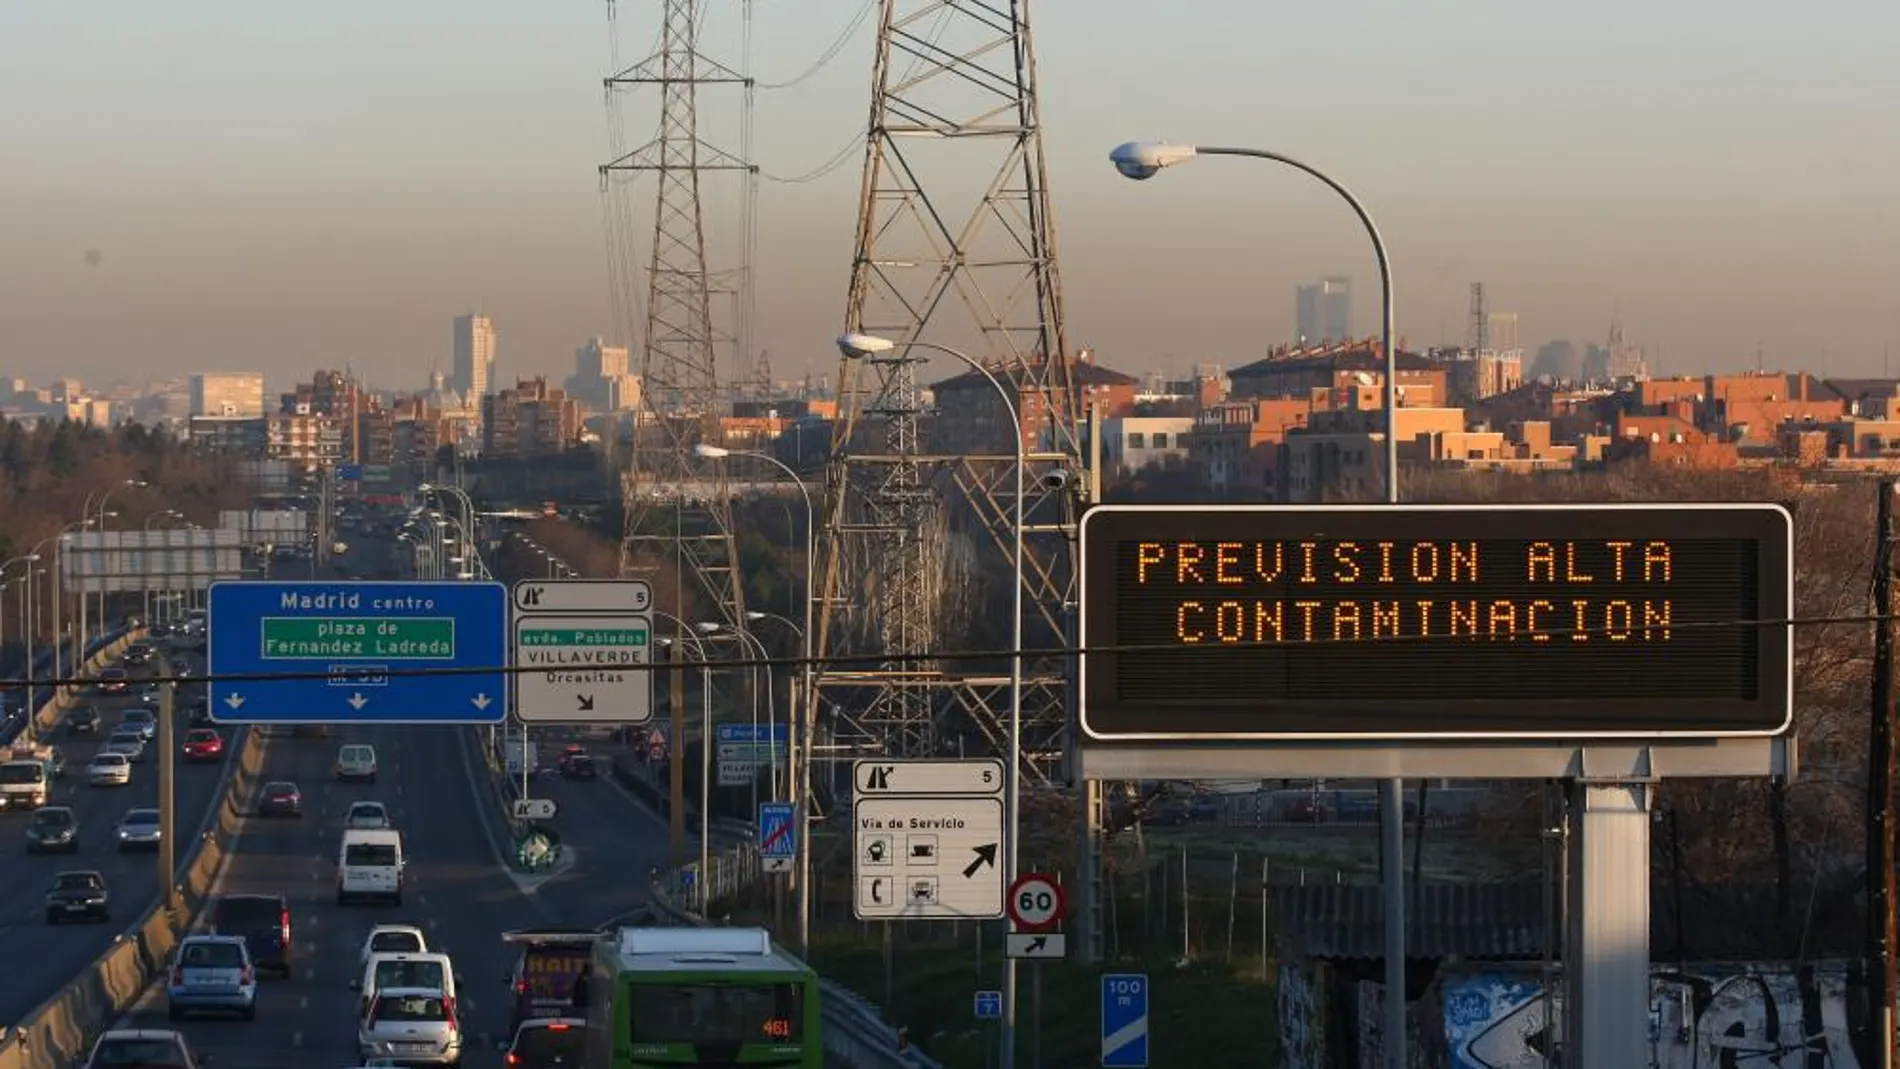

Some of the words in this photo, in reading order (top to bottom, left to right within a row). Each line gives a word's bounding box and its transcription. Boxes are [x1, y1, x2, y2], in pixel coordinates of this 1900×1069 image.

[1138, 541, 1479, 583] PREVISION
[1527, 541, 1672, 582] ALTA
[281, 592, 360, 609] Madrid
[373, 596, 435, 610] centro
[636, 592, 645, 603] 5
[1176, 600, 1672, 643] CONTAMINACION
[318, 621, 366, 637] plaza
[377, 621, 399, 636] de
[575, 631, 644, 645] Poblados
[266, 639, 363, 654] Fernandez
[376, 639, 451, 654] Ladreda
[528, 650, 641, 664] VILLAVERDE
[546, 671, 625, 684] Orcasitas
[982, 770, 993, 783] 5
[861, 818, 884, 829] Via
[888, 818, 904, 829] de
[909, 818, 965, 829] Servicio
[1019, 891, 1052, 912] 60
[1109, 981, 1141, 994] 100
[763, 1018, 788, 1037] 461
